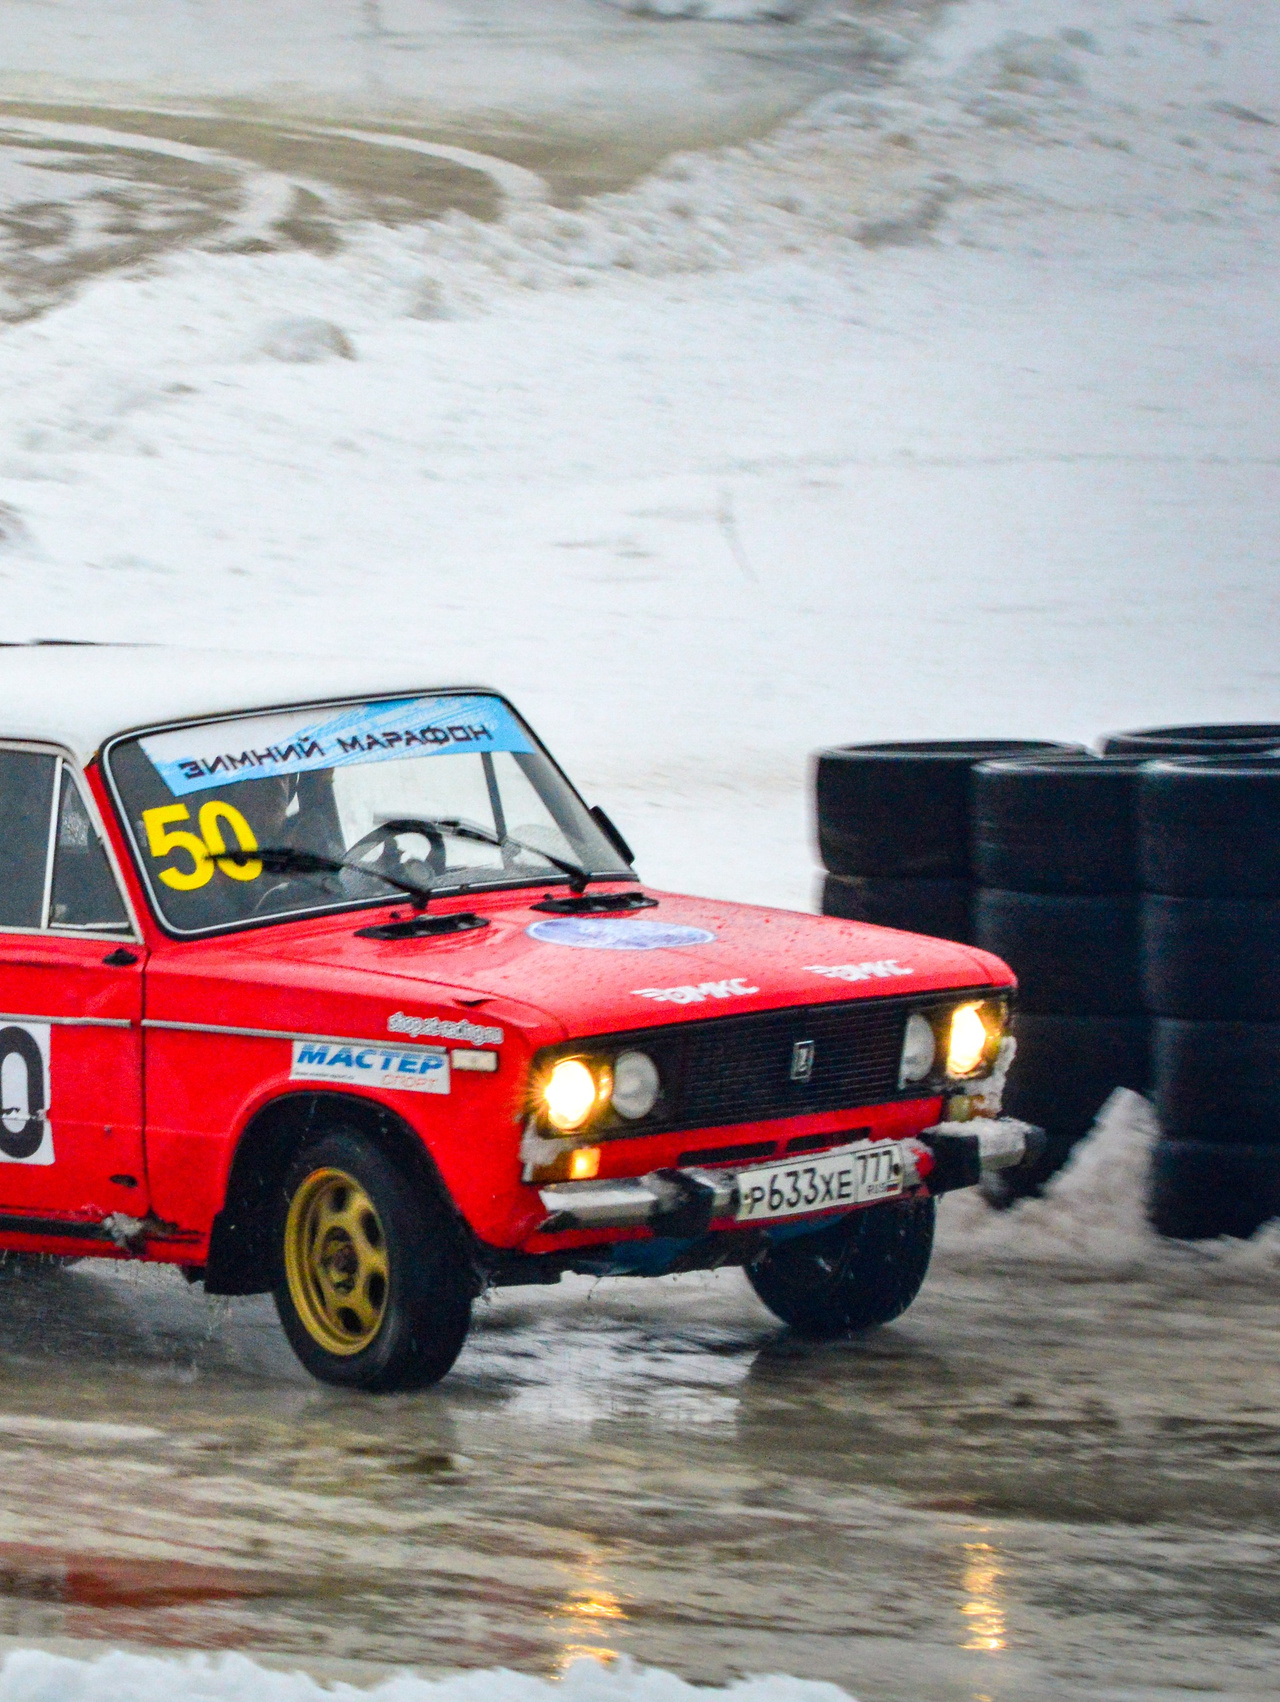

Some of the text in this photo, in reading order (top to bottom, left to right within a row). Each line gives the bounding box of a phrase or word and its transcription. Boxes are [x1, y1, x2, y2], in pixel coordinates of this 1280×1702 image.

[179, 724, 495, 780] ЗИМНИЙ МАРАФОН
[143, 800, 262, 891] 50
[297, 1043, 445, 1075] МАСТЕР
[857, 1149, 894, 1185] 777
